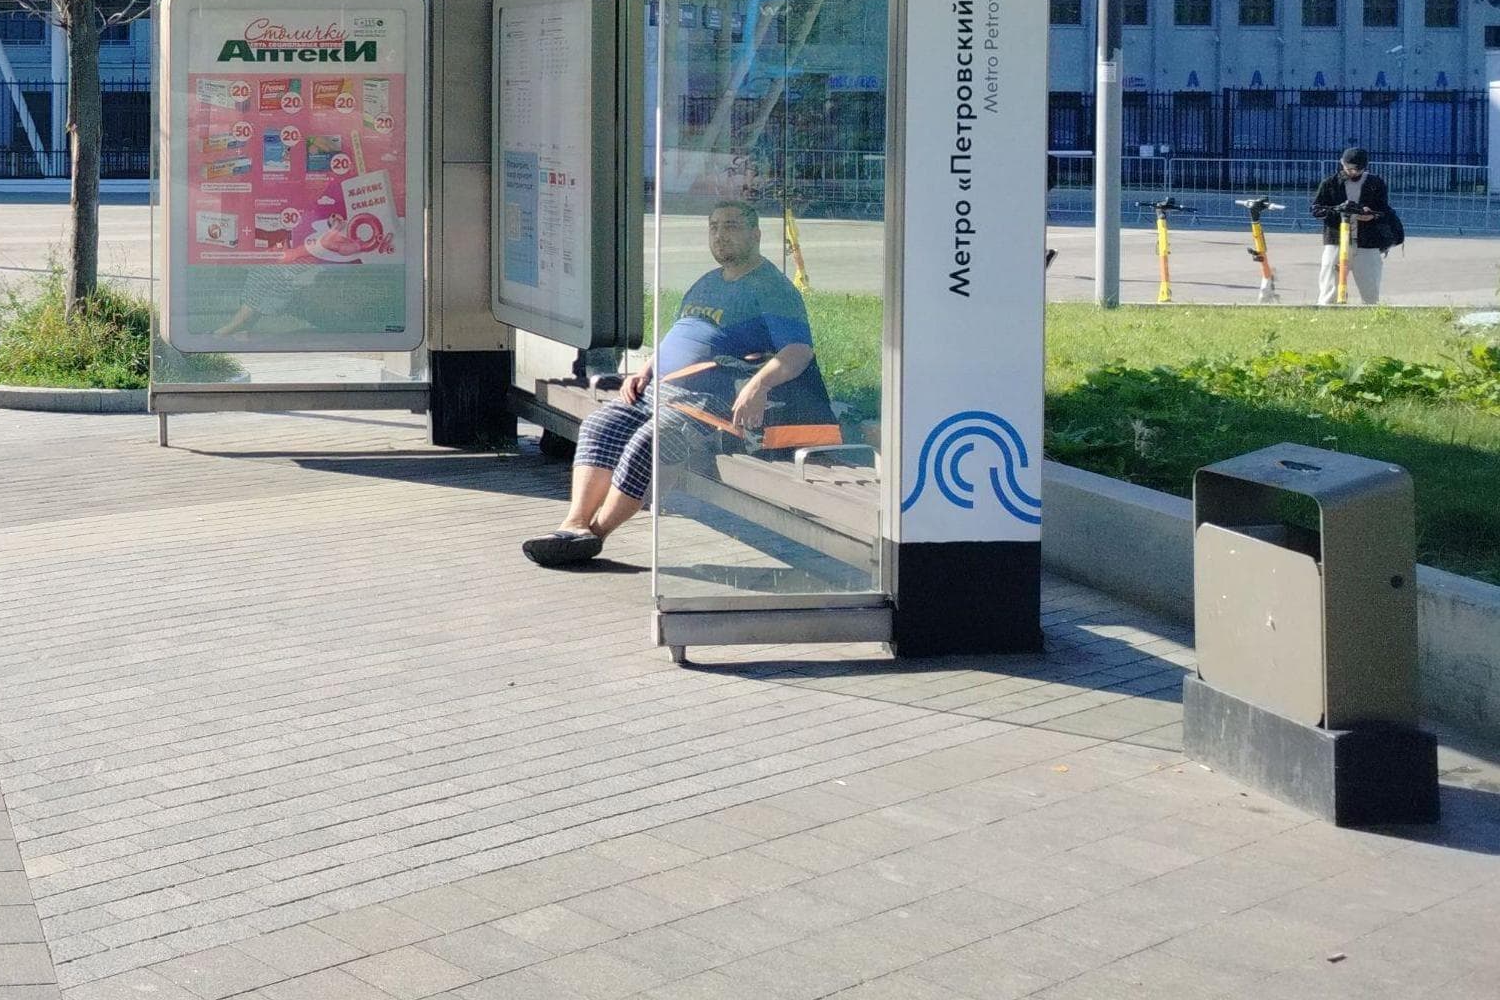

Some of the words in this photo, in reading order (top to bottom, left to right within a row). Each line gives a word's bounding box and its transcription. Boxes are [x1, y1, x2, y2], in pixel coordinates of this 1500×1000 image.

[244, 18, 348, 41] Столички
[983, 55, 1000, 114] Metro
[232, 86, 248, 97] 20
[949, 0, 978, 192] «Петровский
[283, 97, 300, 108] 20
[338, 98, 353, 108] 20
[376, 118, 392, 129] 20
[235, 126, 250, 137] 50
[283, 131, 299, 141] 20
[333, 159, 349, 169] 20
[283, 212, 299, 223] 30
[949, 199, 977, 298] Метро
